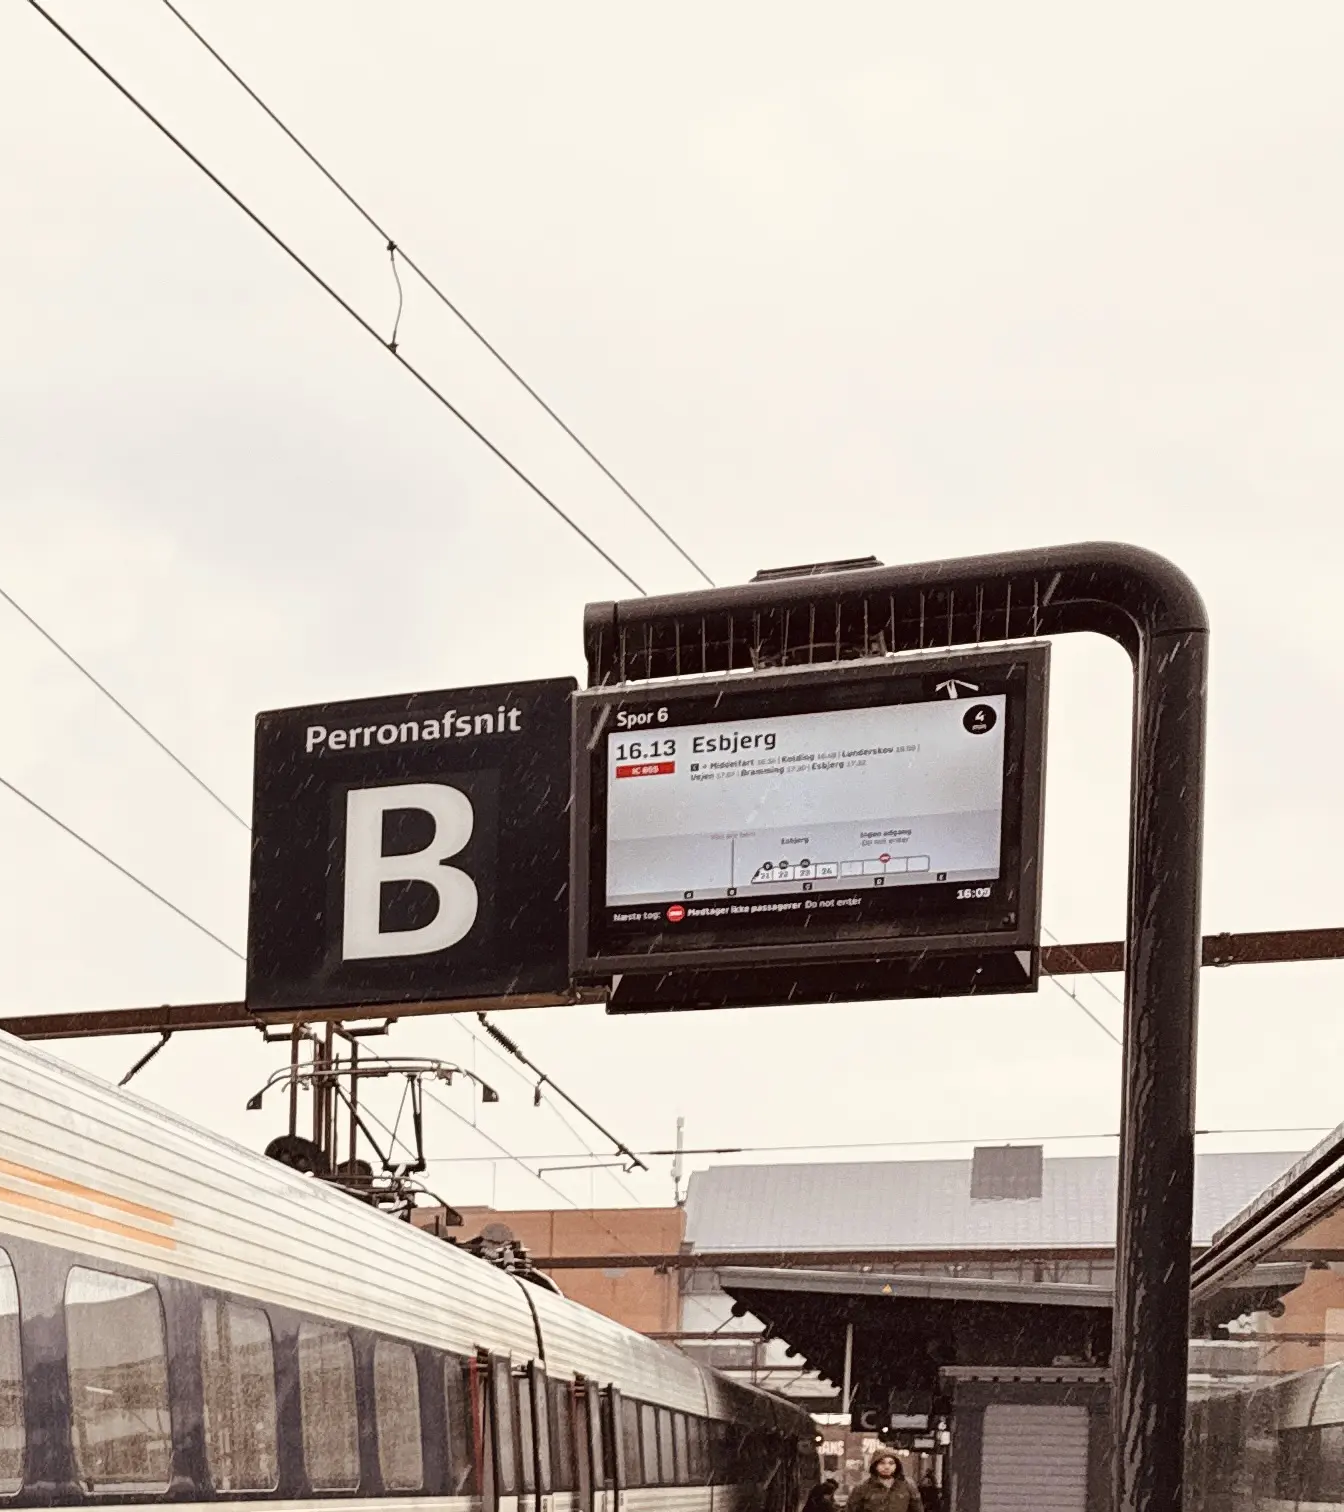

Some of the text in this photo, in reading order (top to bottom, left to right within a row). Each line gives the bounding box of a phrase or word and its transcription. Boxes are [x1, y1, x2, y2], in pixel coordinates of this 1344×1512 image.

[616, 707, 669, 729] Spor 6
[974, 710, 986, 722] 4
[305, 706, 522, 753] Perronafsnit
[616, 739, 677, 761] 16.13
[692, 732, 777, 754] Esbjerg
[811, 761, 845, 771] Esbjerg
[342, 782, 479, 961] B
[818, 899, 835, 908] not
[836, 897, 862, 907] enter
